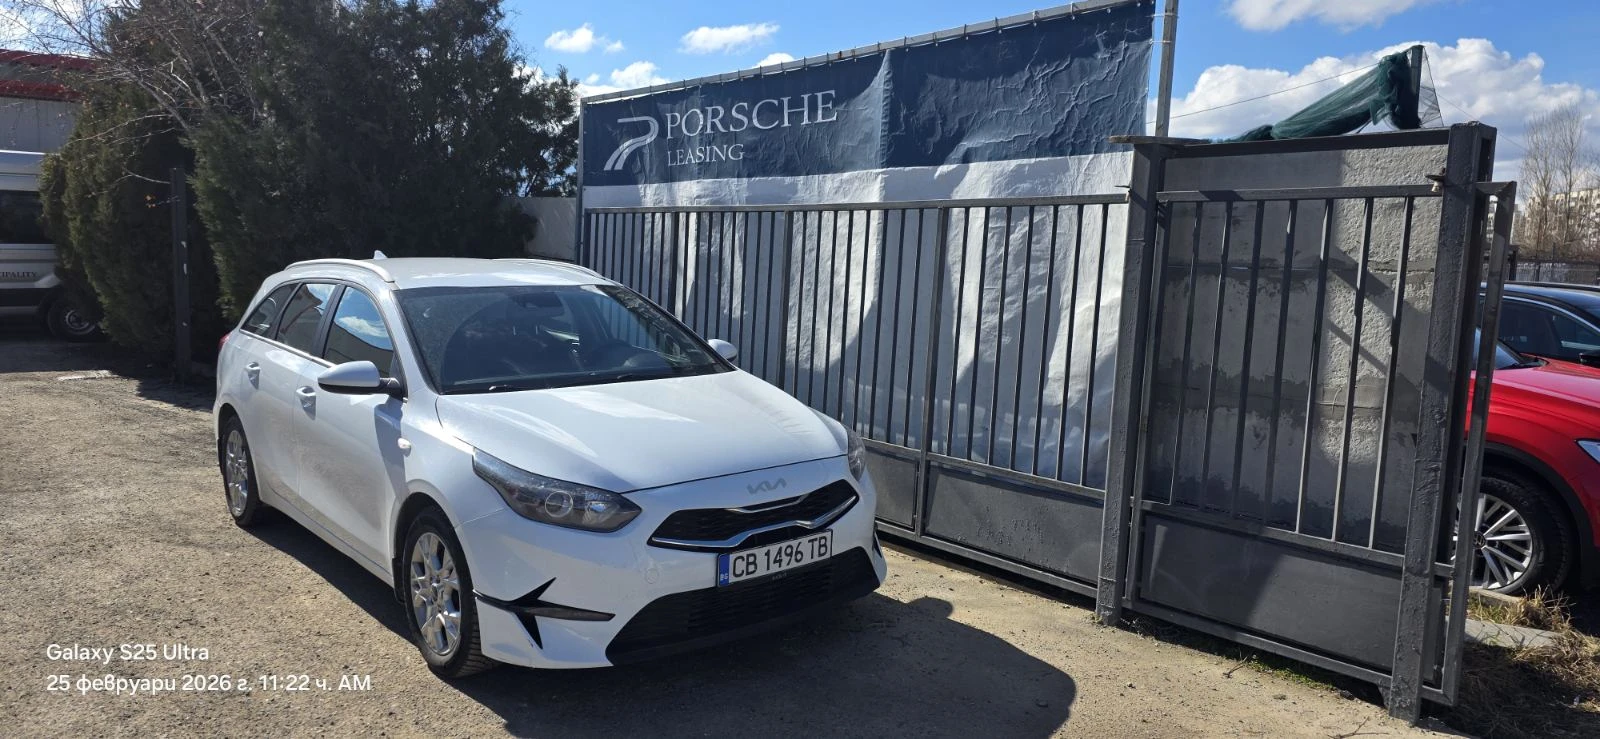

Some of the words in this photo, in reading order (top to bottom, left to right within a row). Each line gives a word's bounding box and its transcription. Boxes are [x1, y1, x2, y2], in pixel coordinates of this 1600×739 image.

[665, 89, 838, 139] PORSCHE
[668, 143, 746, 167] LEASING
[732, 552, 758, 578] CB
[764, 541, 804, 571] 1496
[807, 535, 829, 560] TB
